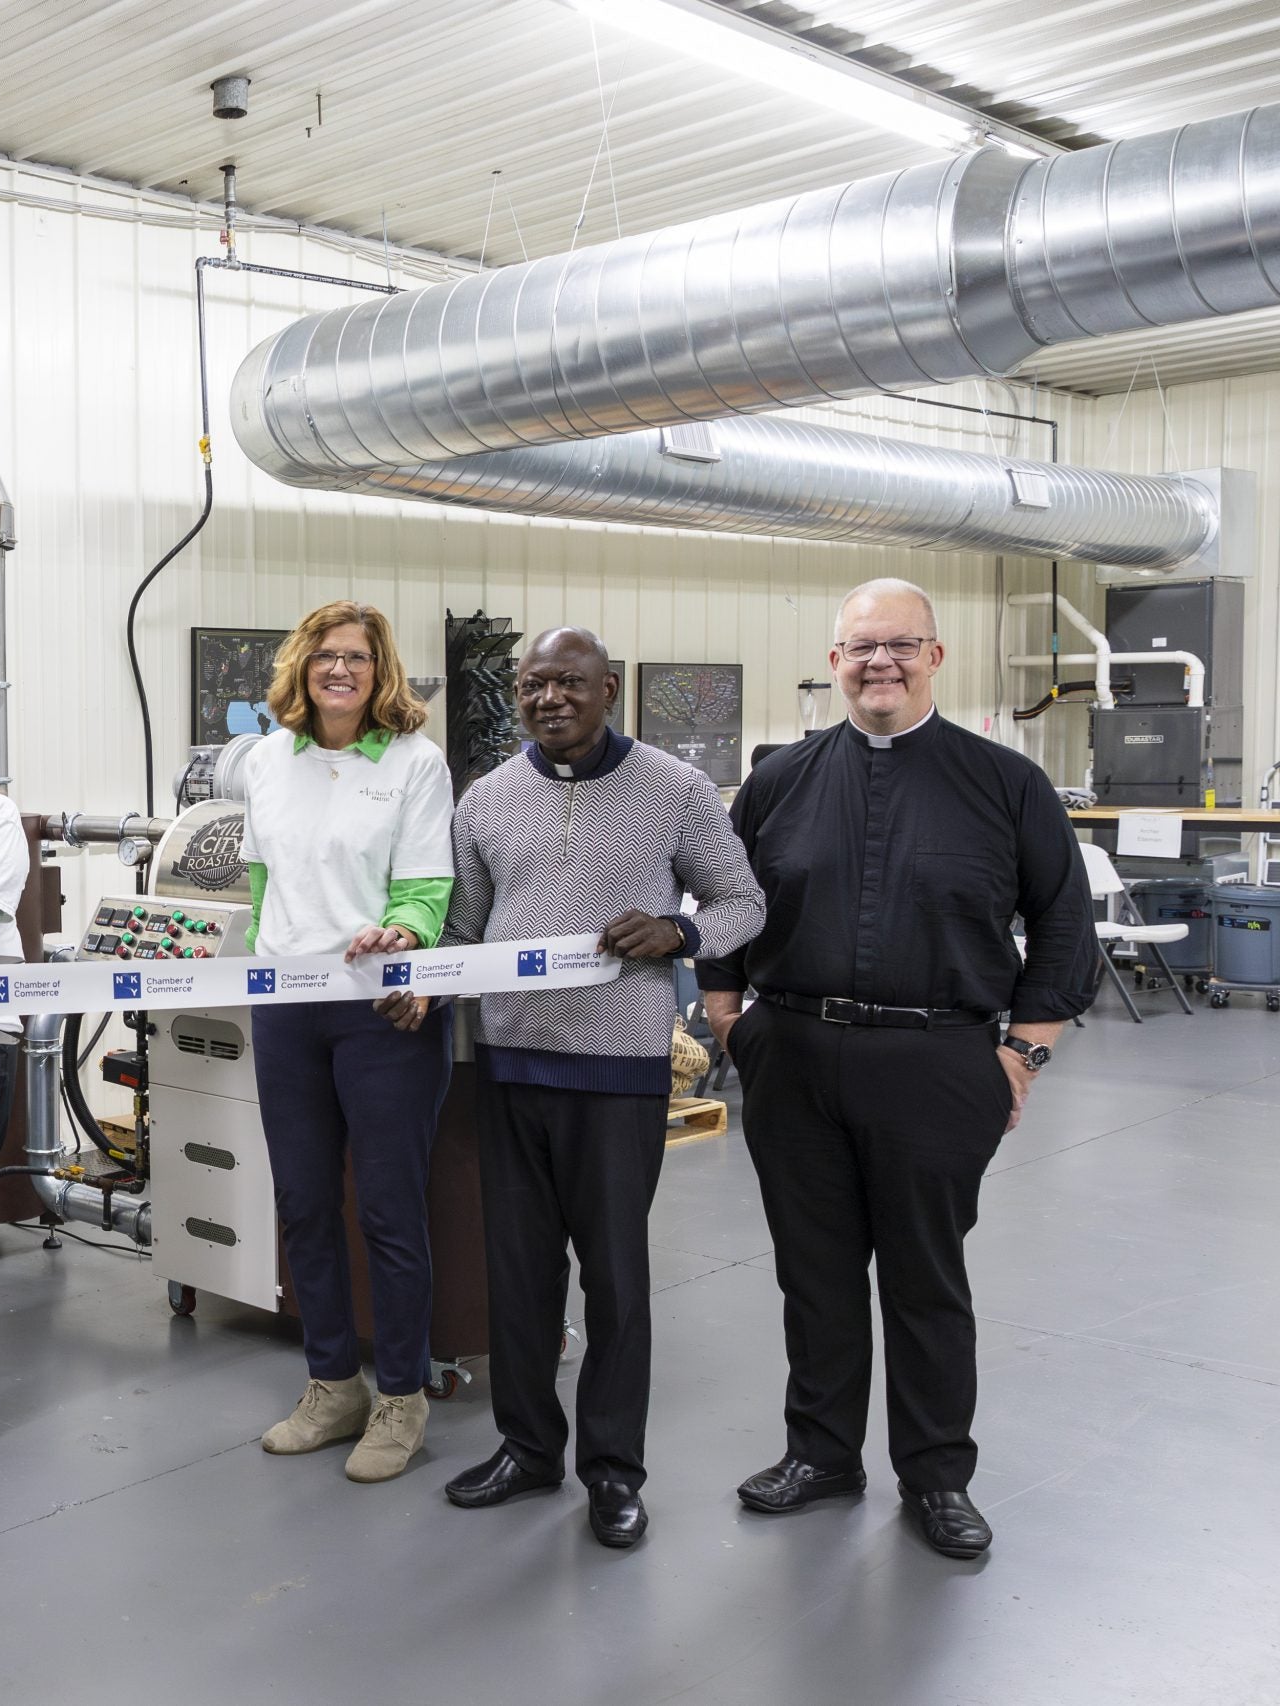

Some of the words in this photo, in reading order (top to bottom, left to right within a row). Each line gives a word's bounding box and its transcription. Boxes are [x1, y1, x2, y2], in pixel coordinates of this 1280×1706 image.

[208, 821, 243, 836] MIL
[552, 953, 591, 961] Chamber
[416, 962, 454, 972] Chamber
[456, 961, 465, 970] of
[552, 960, 601, 969] Commerce
[281, 973, 319, 981] Chamber
[320, 972, 330, 981] of
[416, 970, 462, 980] Commerce
[14, 981, 49, 990] Chamber
[51, 980, 61, 989] of
[146, 977, 183, 986] Chamber
[185, 976, 194, 984] of
[281, 981, 328, 989] Commerce
[14, 989, 59, 998] Commerce
[146, 985, 192, 993] Commerce
